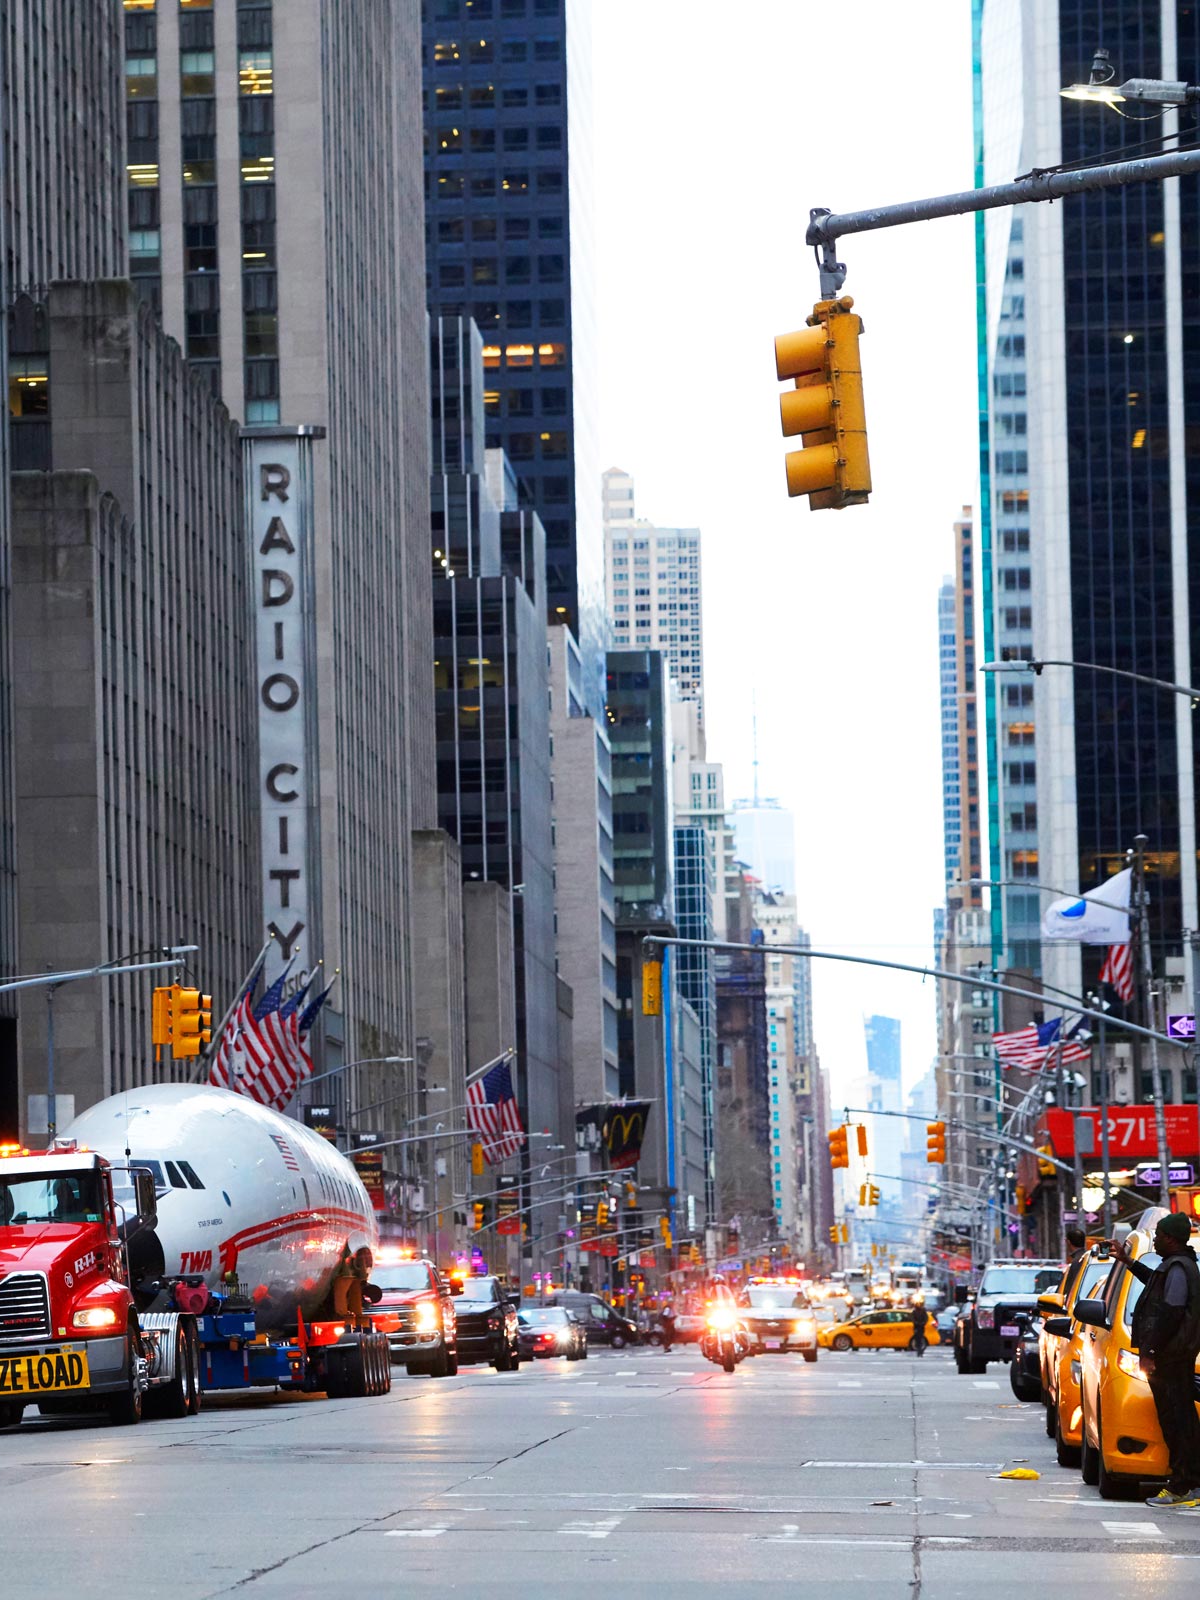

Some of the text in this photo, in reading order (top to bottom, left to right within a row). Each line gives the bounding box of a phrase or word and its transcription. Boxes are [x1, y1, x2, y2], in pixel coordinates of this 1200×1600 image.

[259, 462, 305, 961] RADIO CITY
[179, 1250, 213, 1275] TWA
[26, 1353, 84, 1390] LOAD
